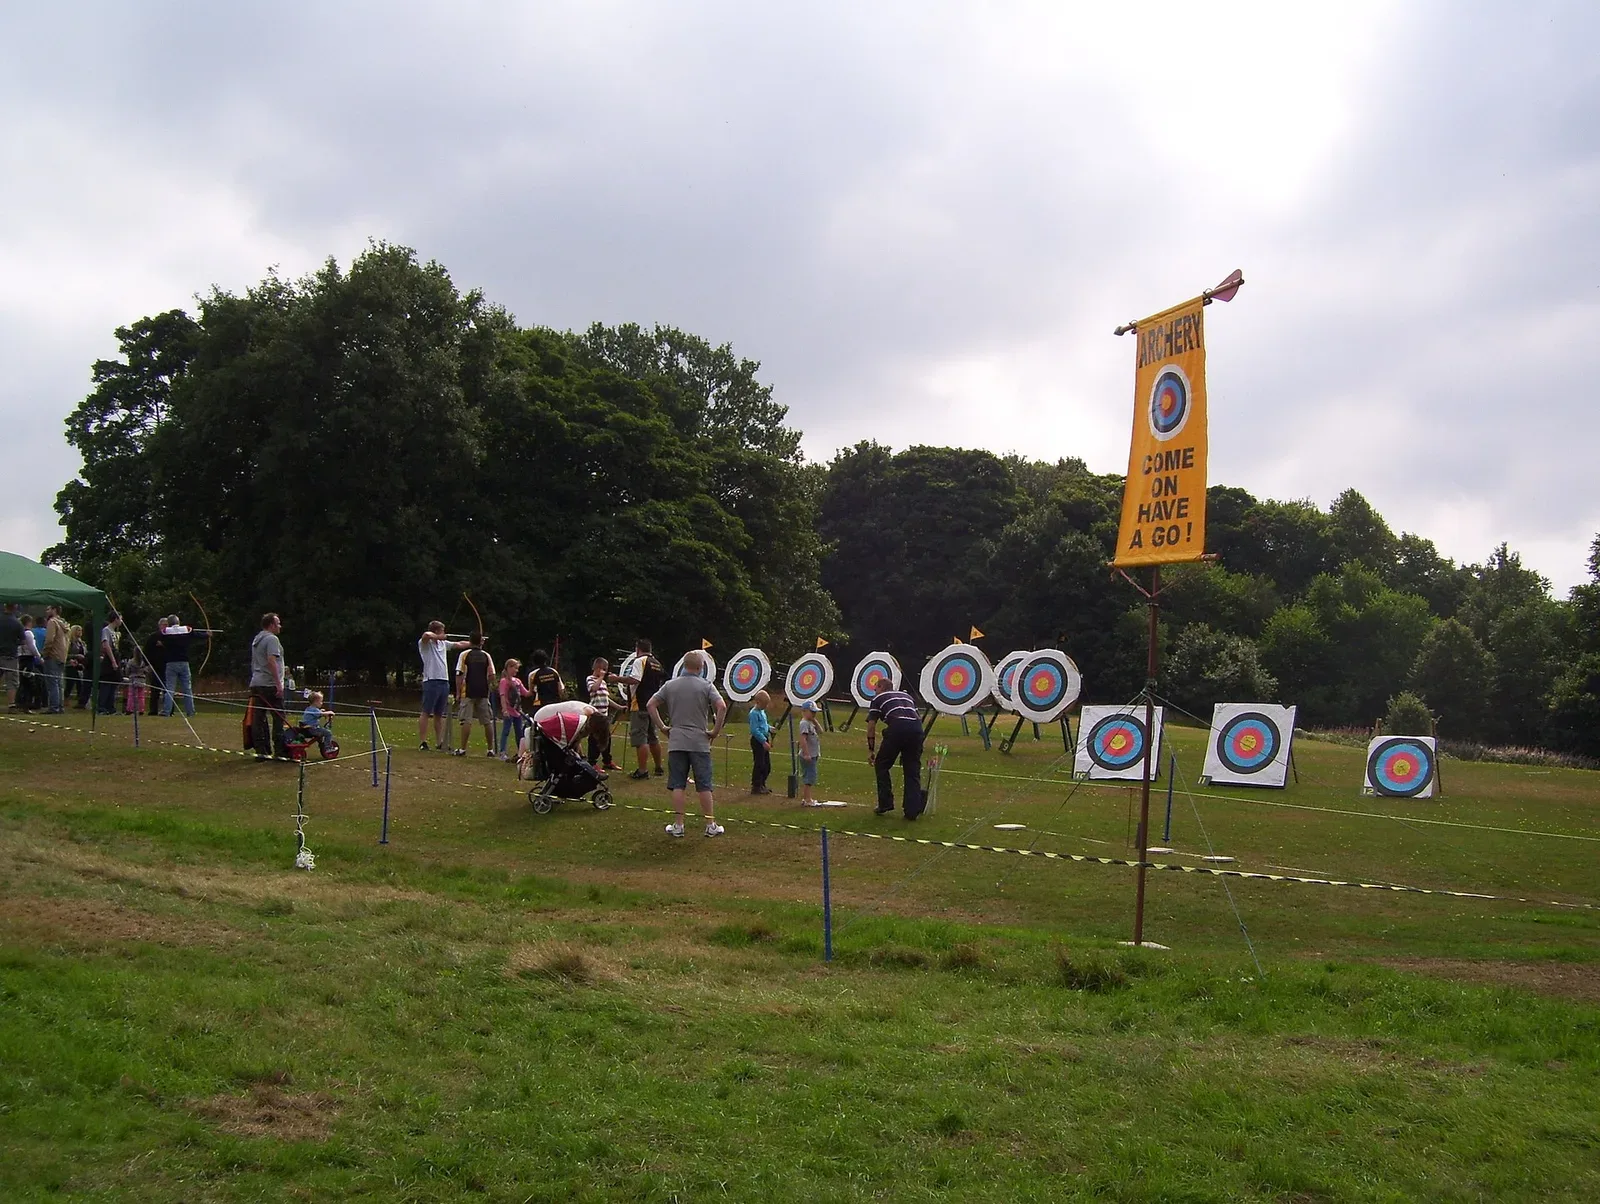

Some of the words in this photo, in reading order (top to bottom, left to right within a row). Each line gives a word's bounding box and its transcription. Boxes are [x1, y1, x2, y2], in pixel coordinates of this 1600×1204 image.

[1139, 310, 1201, 369] ARCHERY
[1142, 447, 1195, 476] COME
[1151, 475, 1178, 498] ON
[1137, 497, 1189, 524] HAVE
[1129, 529, 1143, 549] A
[1363, 787, 1374, 795] 12
